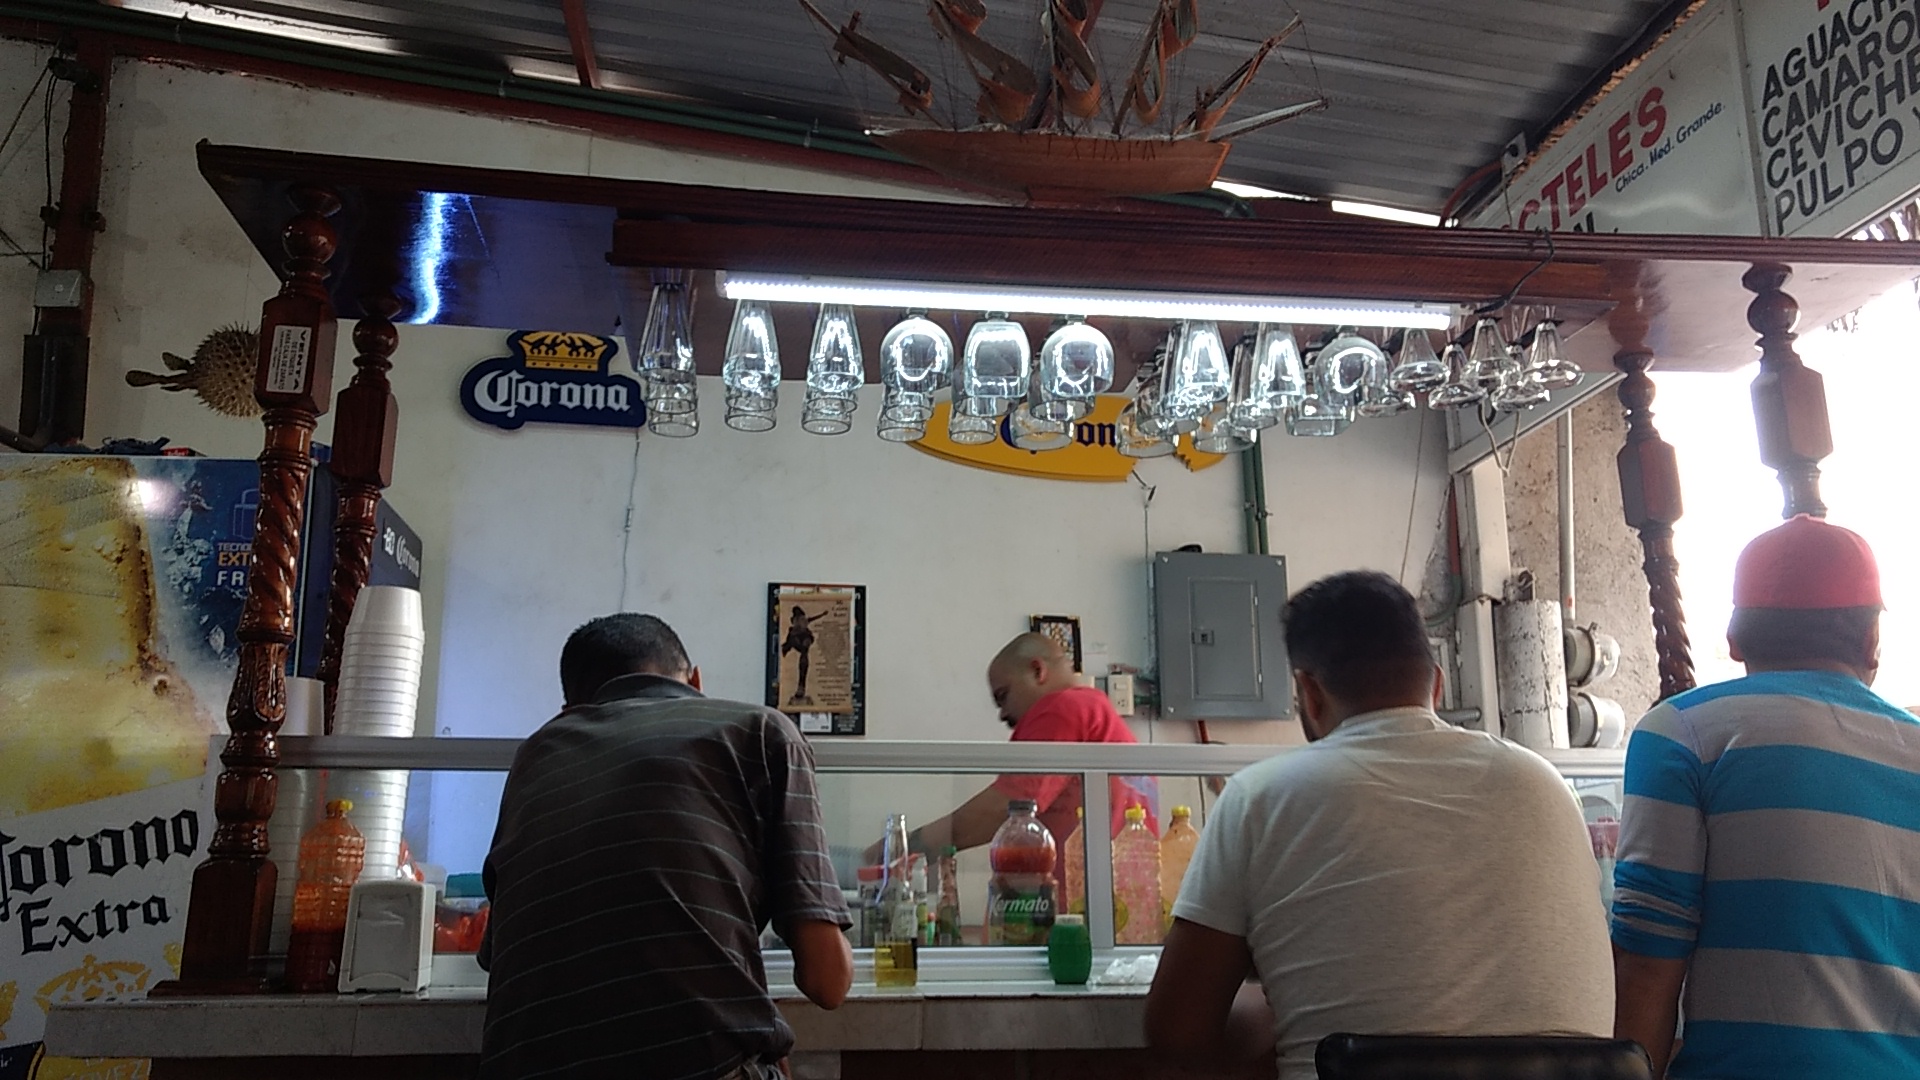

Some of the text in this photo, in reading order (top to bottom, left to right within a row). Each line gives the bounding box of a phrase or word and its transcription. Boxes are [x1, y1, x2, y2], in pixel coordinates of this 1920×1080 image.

[1676, 101, 1726, 144] Grande.
[1500, 86, 1667, 234] CTELES
[1775, 118, 1904, 236] PULPO
[293, 329, 307, 391] VENTA
[474, 369, 631, 418] Corona
[217, 570, 245, 586] FR
[218, 551, 252, 567] EXT
[16, 895, 171, 955] Extra
